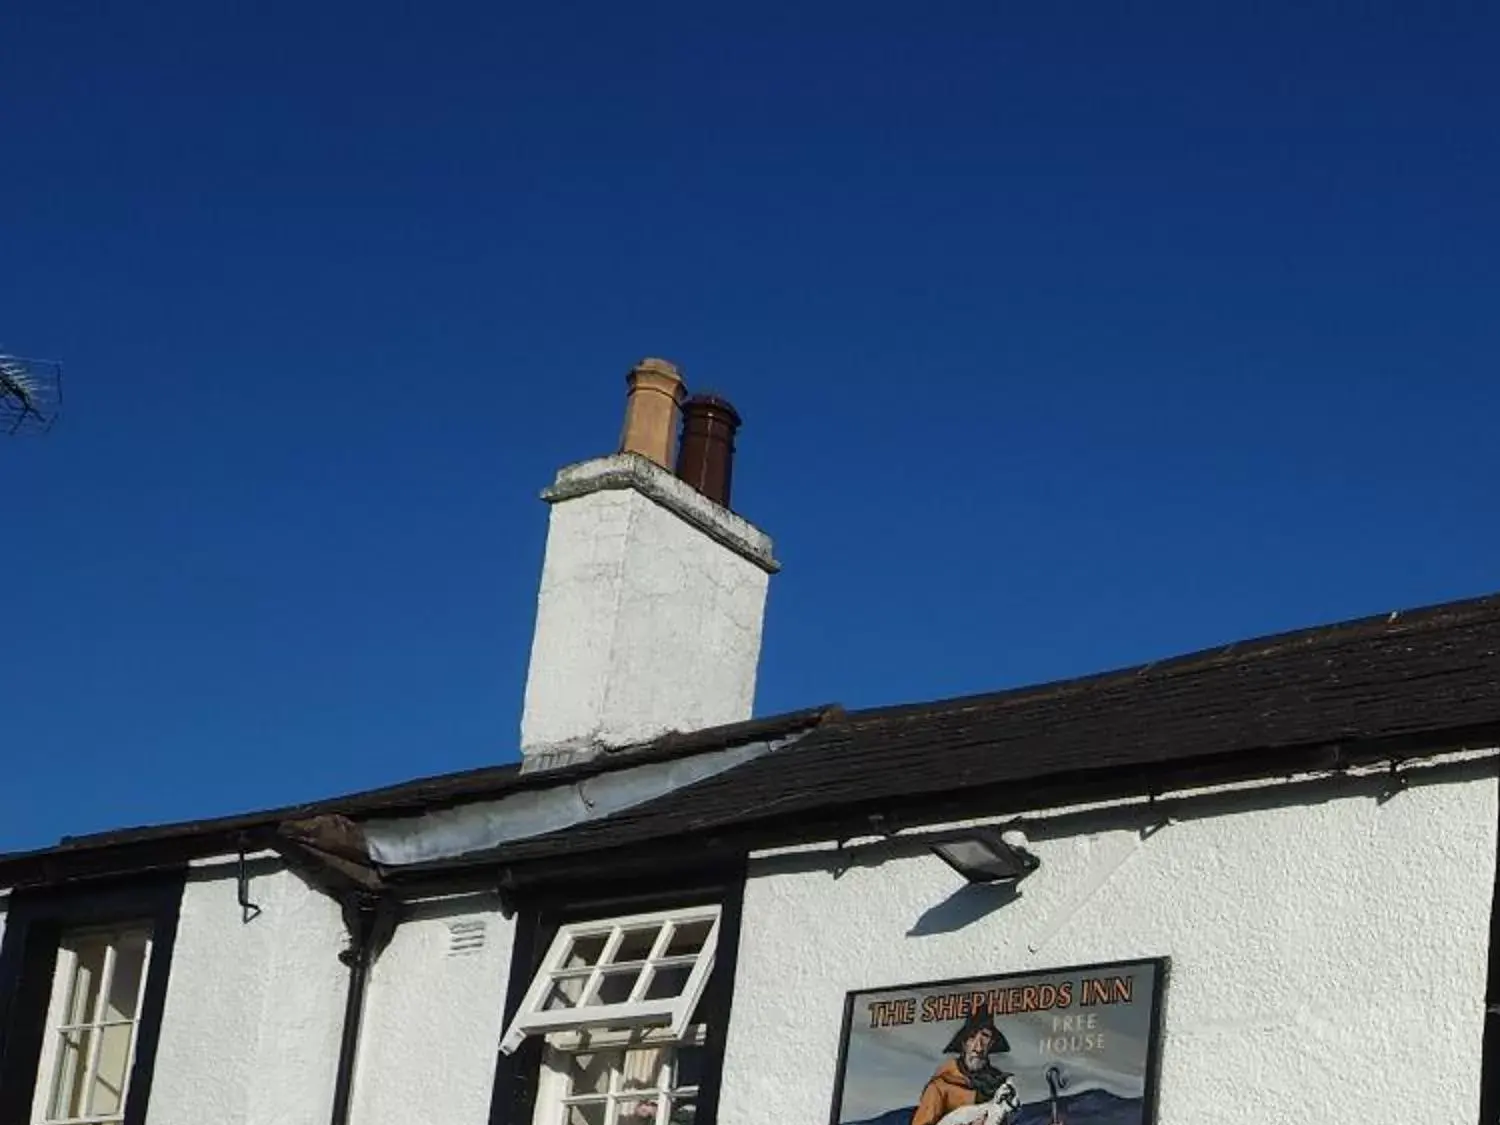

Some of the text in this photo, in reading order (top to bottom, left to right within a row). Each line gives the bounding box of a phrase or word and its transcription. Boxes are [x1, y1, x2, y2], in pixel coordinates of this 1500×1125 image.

[868, 976, 1133, 1029] THE SHEPHERDS INN
[1052, 1013, 1099, 1033] FREE
[1039, 1033, 1105, 1055] HOUSE
